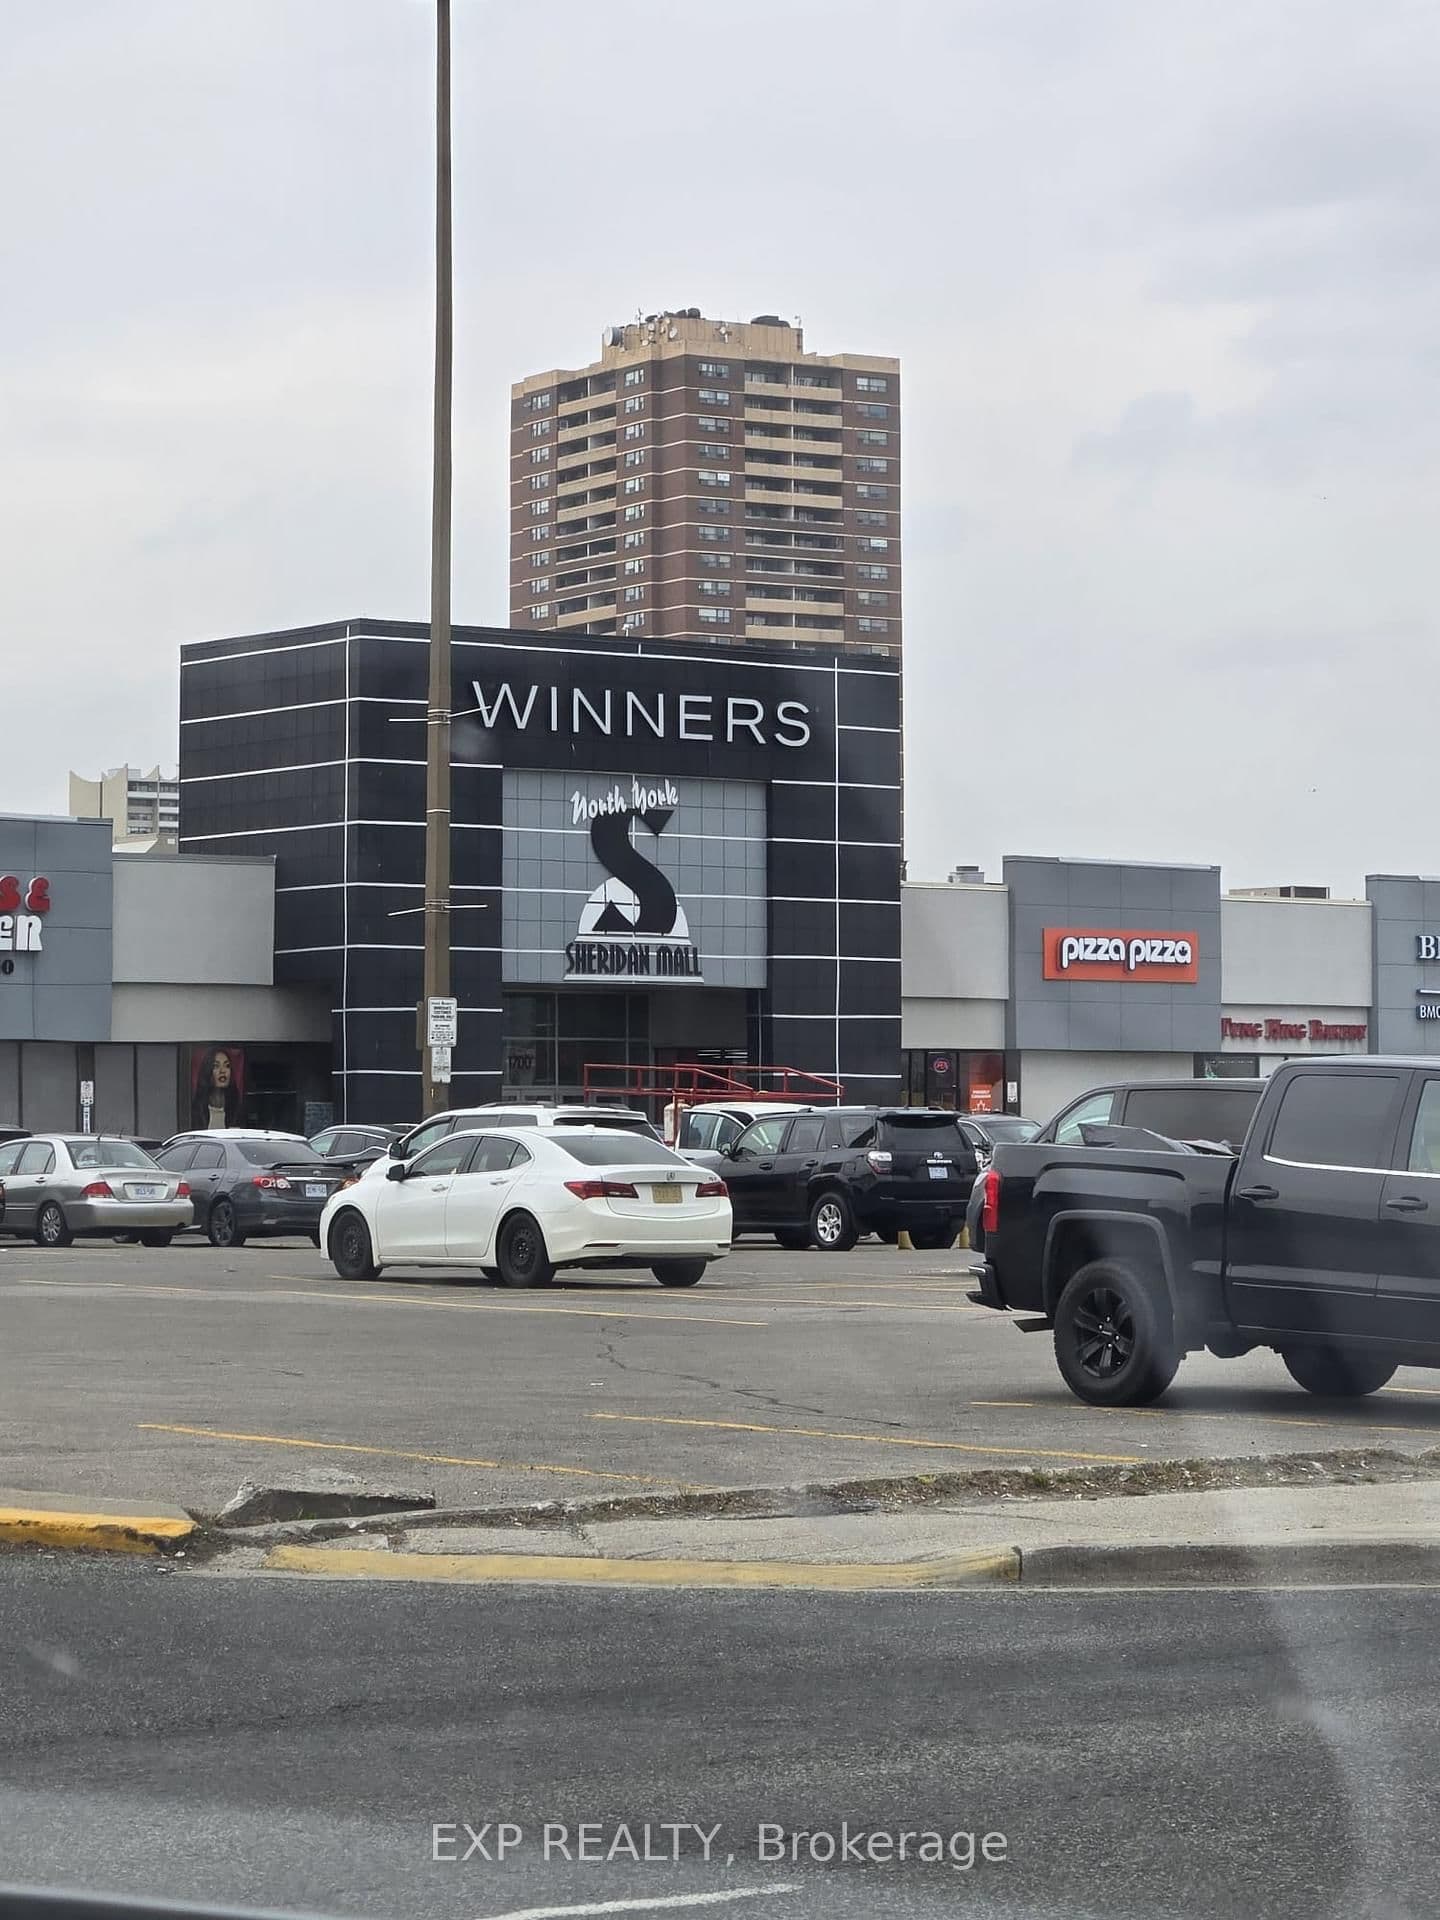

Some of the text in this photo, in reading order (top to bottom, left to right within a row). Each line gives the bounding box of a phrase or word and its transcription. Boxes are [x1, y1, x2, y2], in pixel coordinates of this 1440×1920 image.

[471, 680, 812, 748] WINNERS
[571, 778, 679, 825] North York
[565, 942, 703, 977] SHERIDAN MALL
[1061, 936, 1192, 972] pizza pizza
